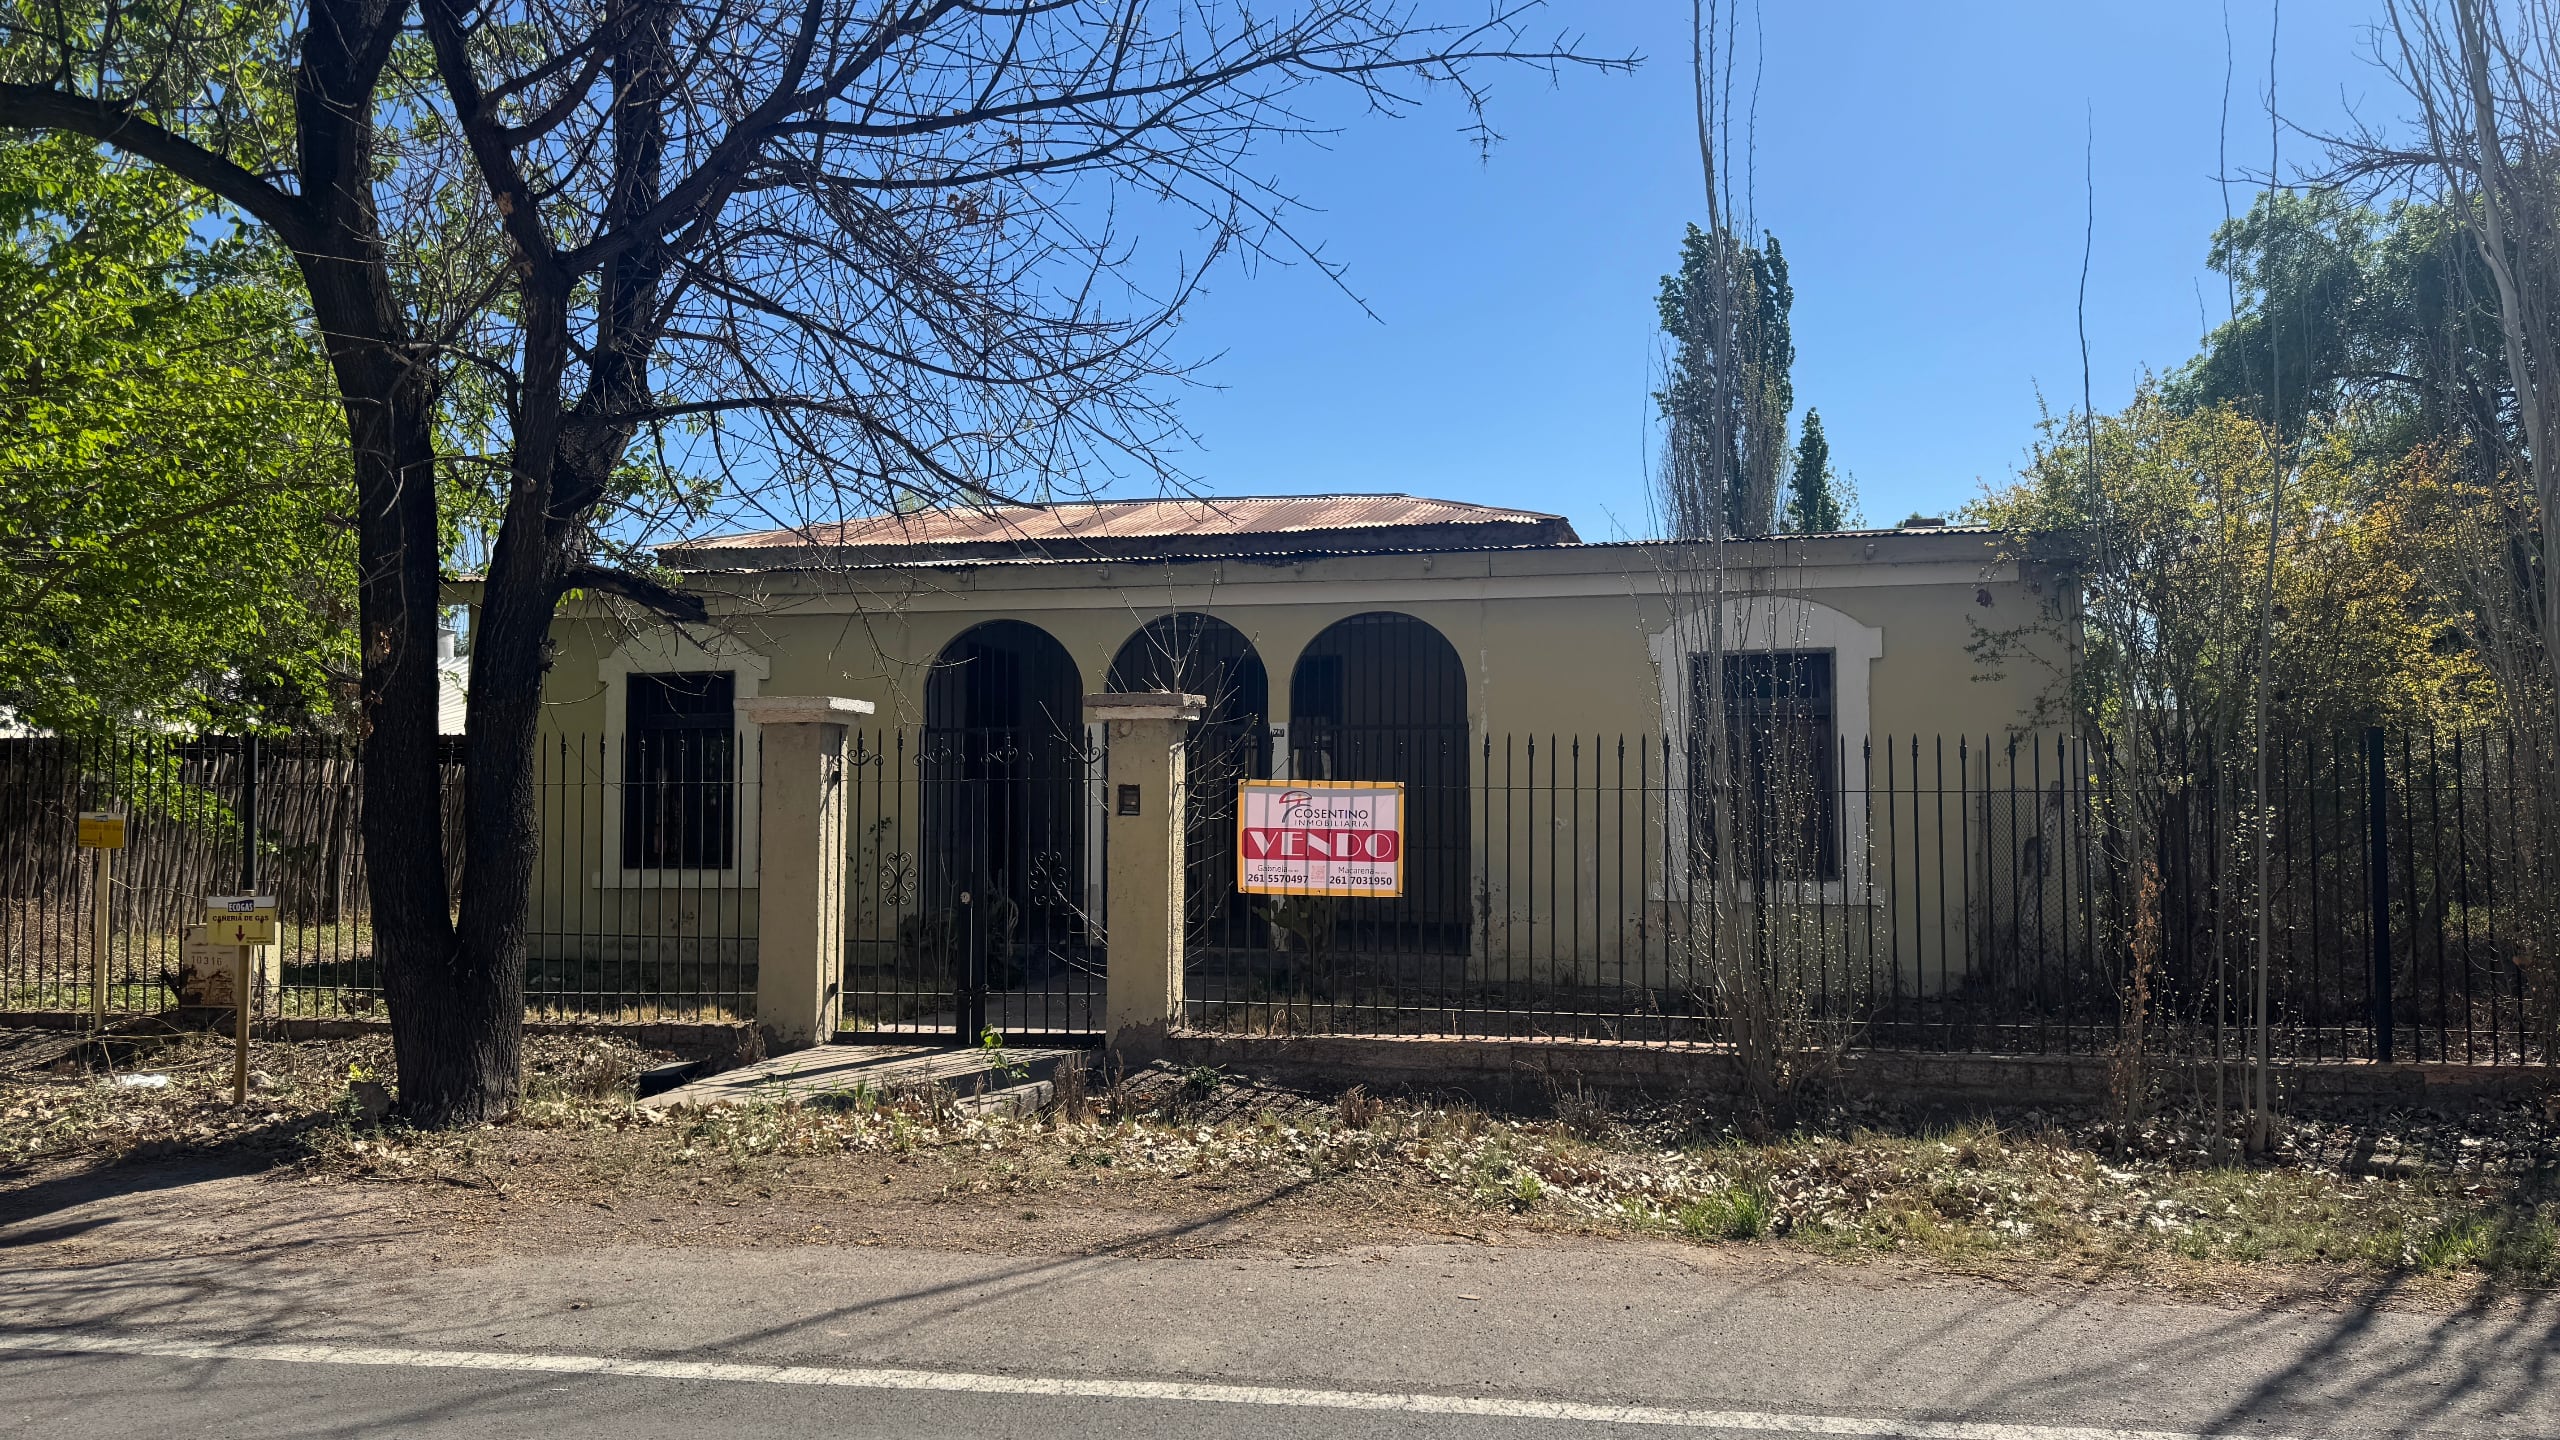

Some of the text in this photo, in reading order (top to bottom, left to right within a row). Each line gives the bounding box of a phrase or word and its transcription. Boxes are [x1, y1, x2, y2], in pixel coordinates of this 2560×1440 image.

[1295, 808, 1369, 820] COSENTINO
[1295, 820, 1369, 828] INMOBILIARIA
[1249, 831, 1392, 859] VENDO
[1247, 873, 1308, 884] 261 5570497
[1329, 875, 1392, 886] 261 7031950
[228, 902, 253, 912] ECOGAS
